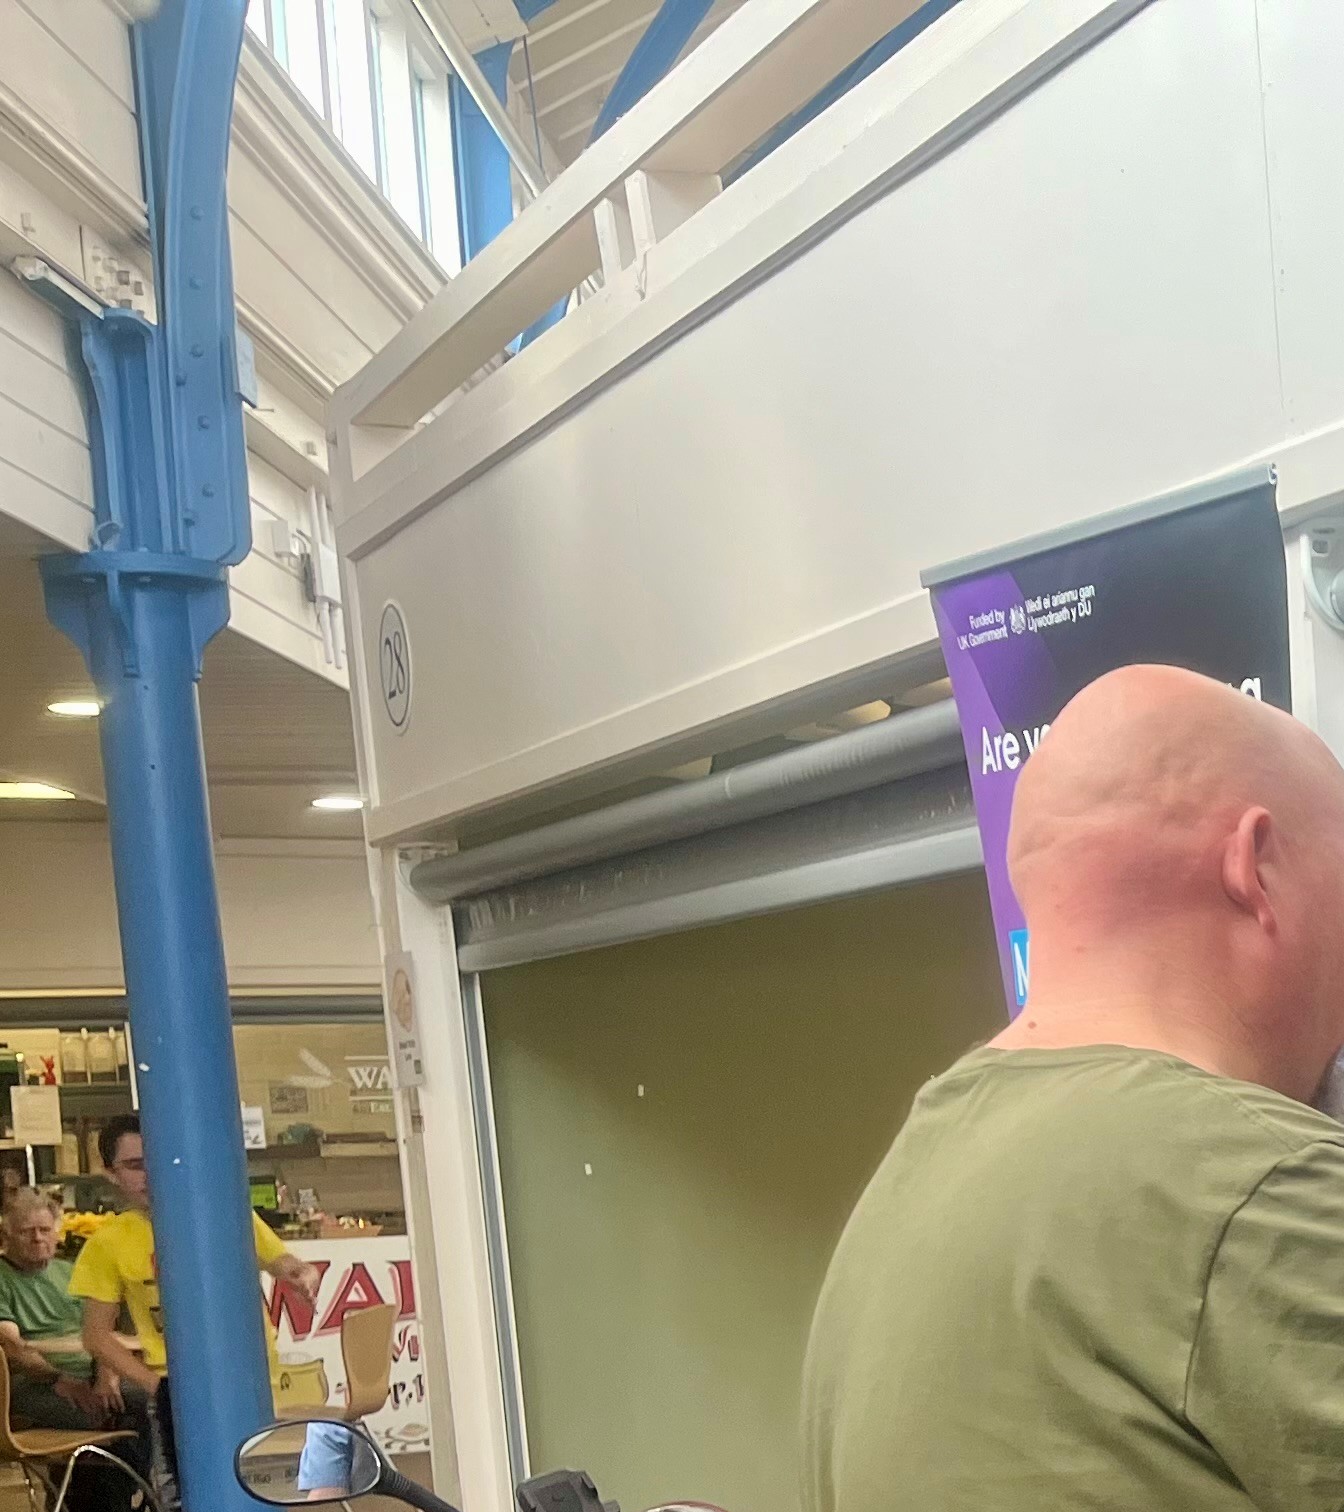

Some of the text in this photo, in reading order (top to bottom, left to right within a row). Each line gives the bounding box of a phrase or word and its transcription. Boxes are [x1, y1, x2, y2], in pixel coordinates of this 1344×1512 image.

[1079, 584, 1096, 601] gan
[969, 609, 1006, 630] Funded by
[1077, 600, 1092, 617] DU
[957, 624, 1009, 651] UK Government
[384, 631, 406, 699] 28
[981, 726, 1021, 775] Are
